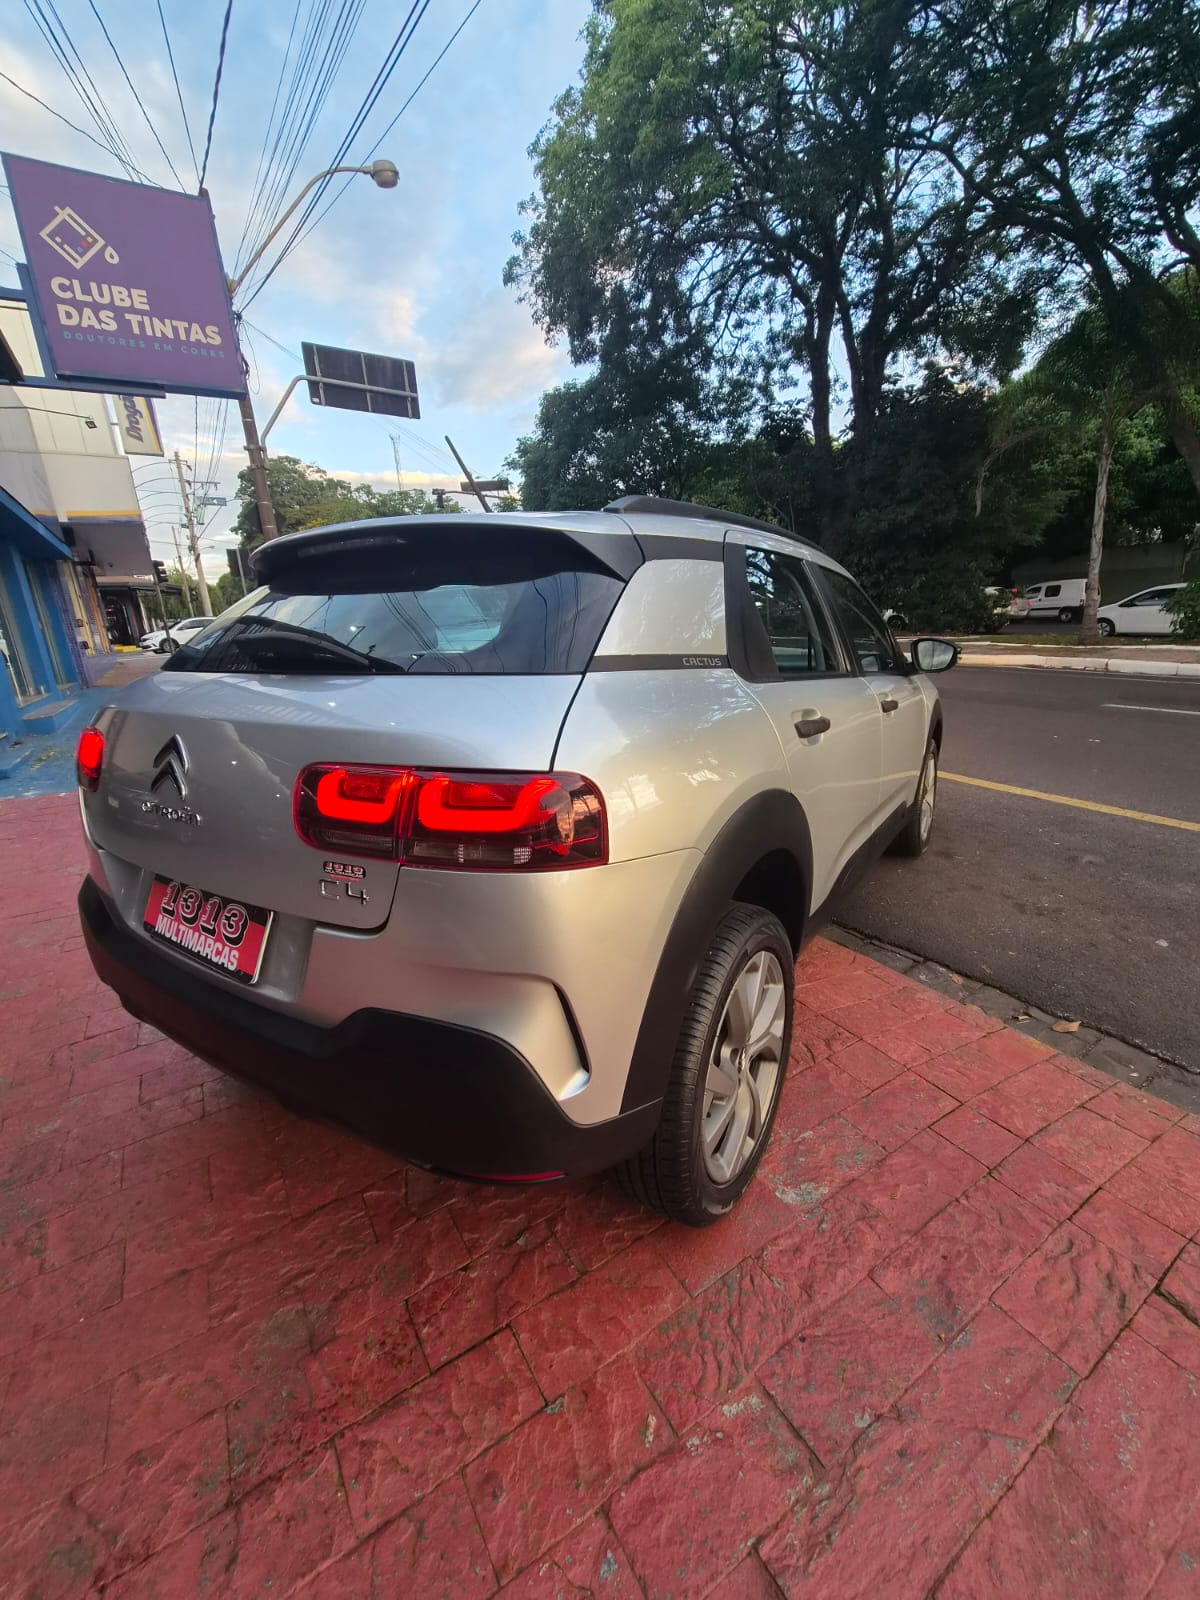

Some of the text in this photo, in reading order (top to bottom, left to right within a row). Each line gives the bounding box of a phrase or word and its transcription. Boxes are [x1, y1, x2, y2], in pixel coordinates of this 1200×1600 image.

[51, 276, 150, 311] CLUBE
[57, 304, 222, 345] DAS TINTAS
[63, 331, 225, 358] DOUTORES EM CORES
[682, 657, 722, 666] CACTUS
[319, 879, 369, 905] C4
[160, 881, 250, 948] 1313
[155, 913, 239, 971] MULTIMARCAS
